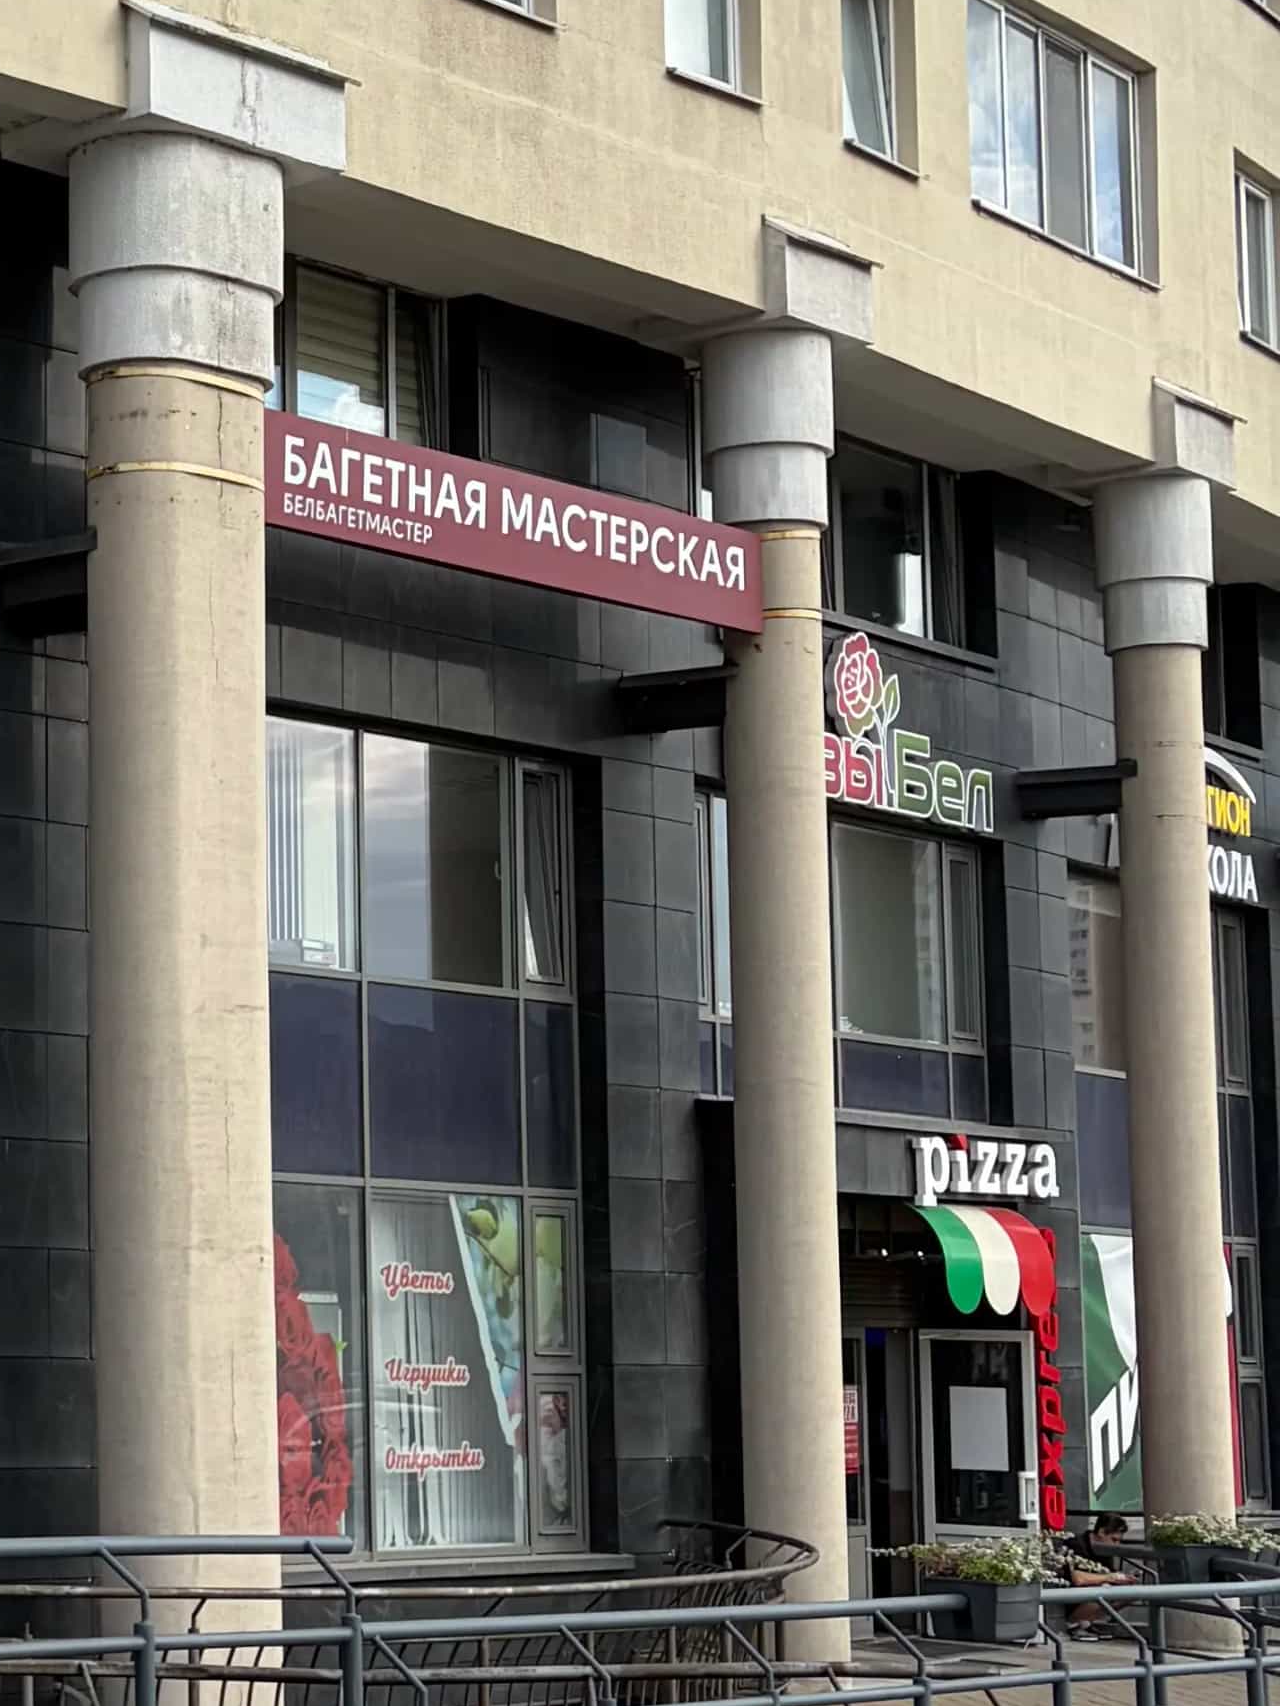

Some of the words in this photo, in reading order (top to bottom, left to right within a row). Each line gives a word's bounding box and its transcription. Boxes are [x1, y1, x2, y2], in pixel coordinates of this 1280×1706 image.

[283, 434, 487, 530] БАГЕТНАЯ
[501, 487, 745, 592] МАСТЕРСКАЯ
[283, 493, 433, 545] БЕЛБАГЕТМАСТЕР
[915, 1132, 1061, 1207] pizza
[380, 1263, 454, 1299] Цветы
[383, 1356, 470, 1394] Игрушки
[384, 1441, 484, 1481] Открытки
